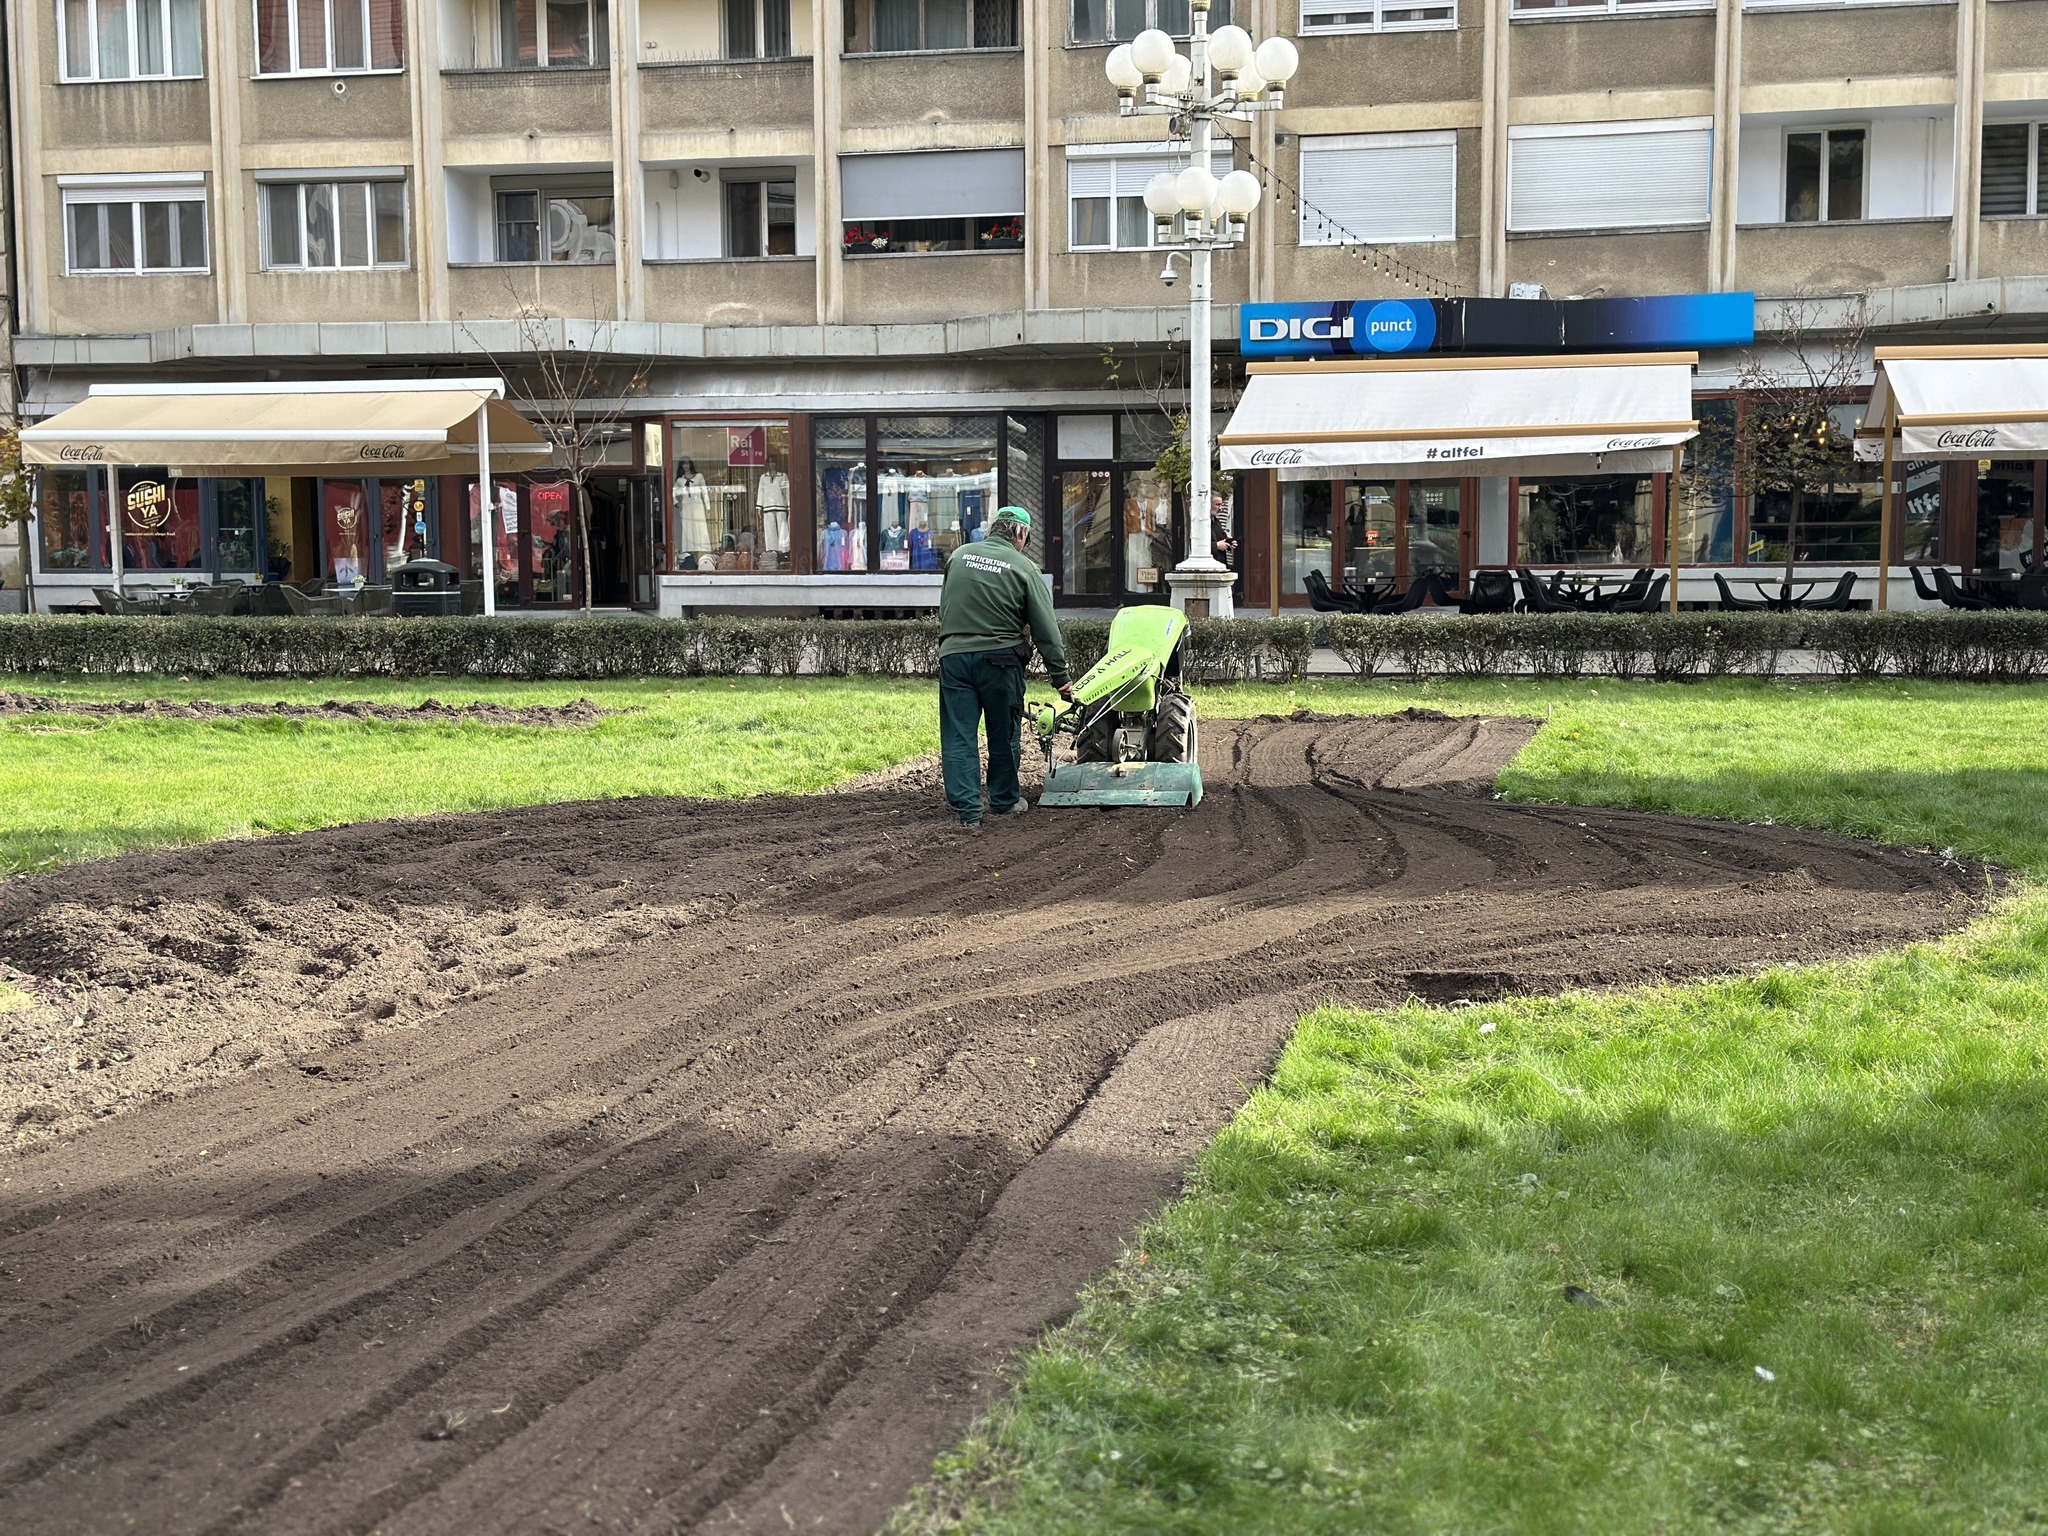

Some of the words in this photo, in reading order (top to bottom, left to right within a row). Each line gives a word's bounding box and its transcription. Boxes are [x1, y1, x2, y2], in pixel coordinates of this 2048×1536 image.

[1249, 316, 1354, 341] DIGI
[1370, 318, 1413, 336] punct
[730, 434, 753, 449] Rai
[1937, 429, 1999, 448] Coca-Cola
[360, 444, 405, 460] Coca-Cola
[740, 449, 764, 457] Stre
[1250, 448, 1305, 466] Coca-Cola
[127, 484, 166, 511] SUSHI
[537, 491, 563, 500] OPEN
[140, 504, 159, 519] YA
[962, 553, 1012, 570] HORTICULTURA
[965, 561, 1002, 574] TIMISOARA
